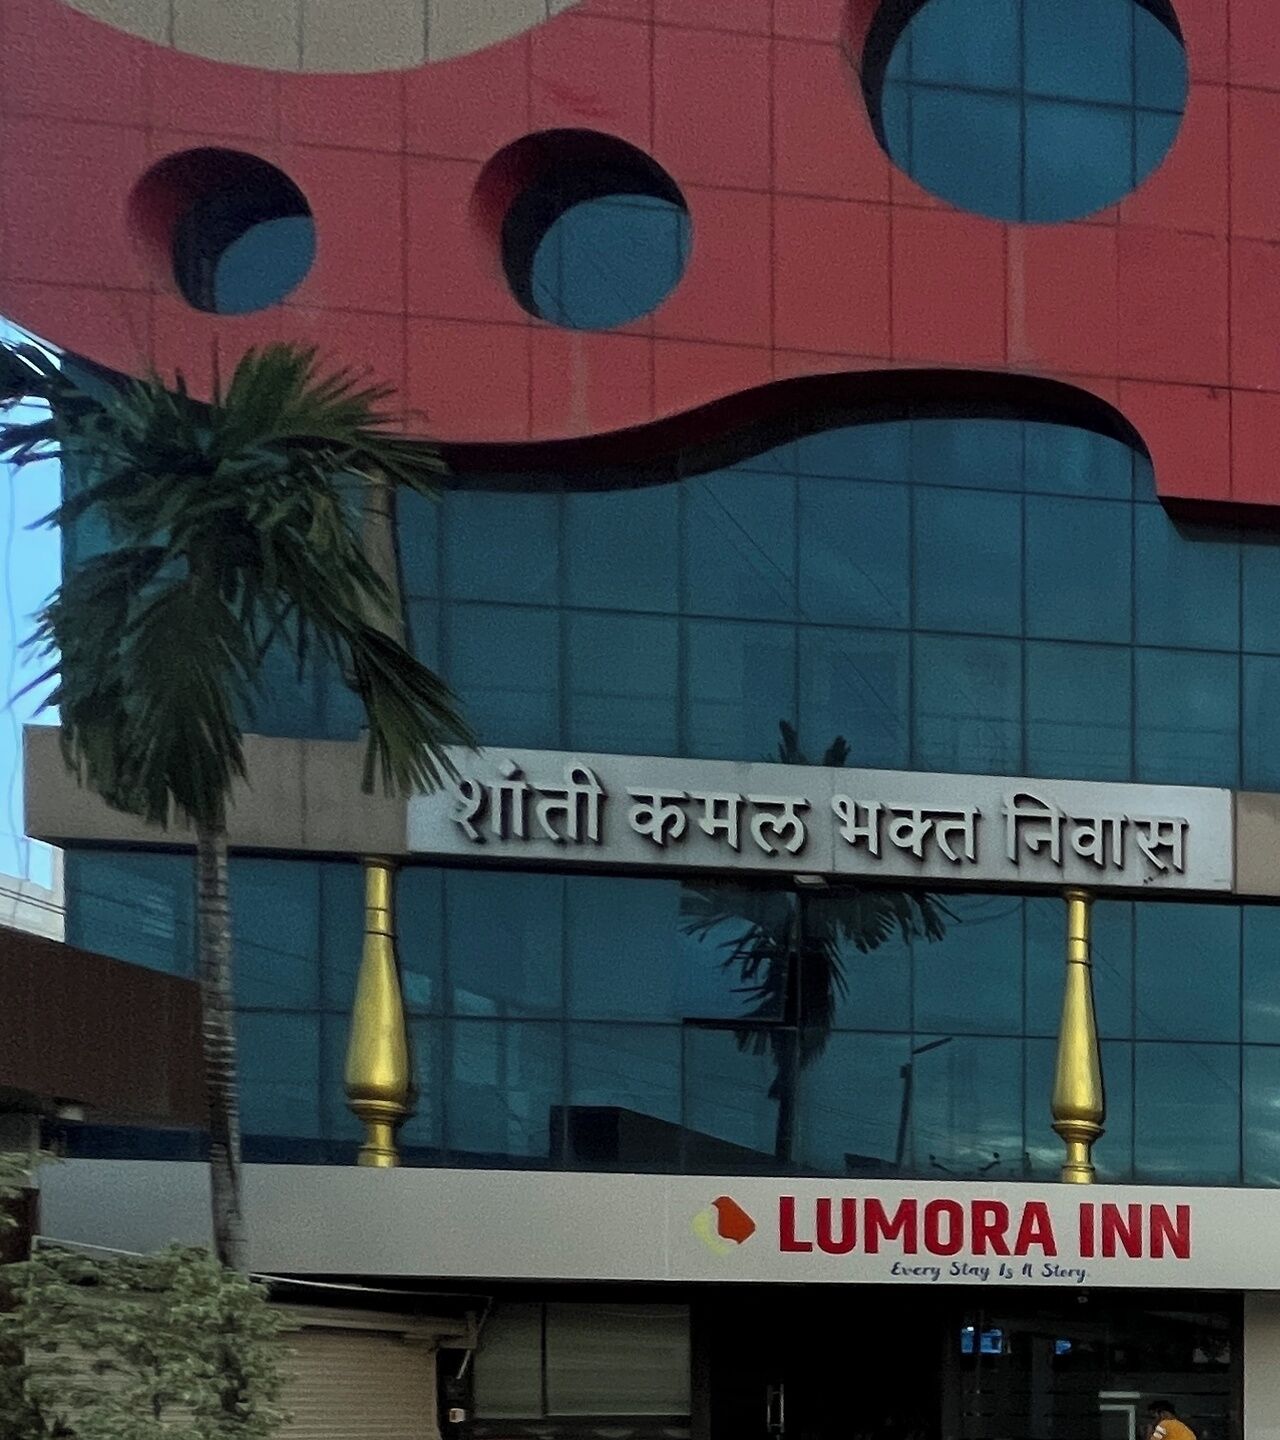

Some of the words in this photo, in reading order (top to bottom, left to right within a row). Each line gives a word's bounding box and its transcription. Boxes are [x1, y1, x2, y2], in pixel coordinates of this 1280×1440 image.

[449, 759, 608, 842] शांती
[626, 786, 812, 856] कमल
[832, 794, 982, 864] भक्त
[1001, 792, 1193, 873] निवास
[779, 1197, 1058, 1257] LUMORA
[1079, 1203, 1191, 1259] INN
[890, 1261, 941, 1282] Every
[949, 1261, 990, 1282] Stay
